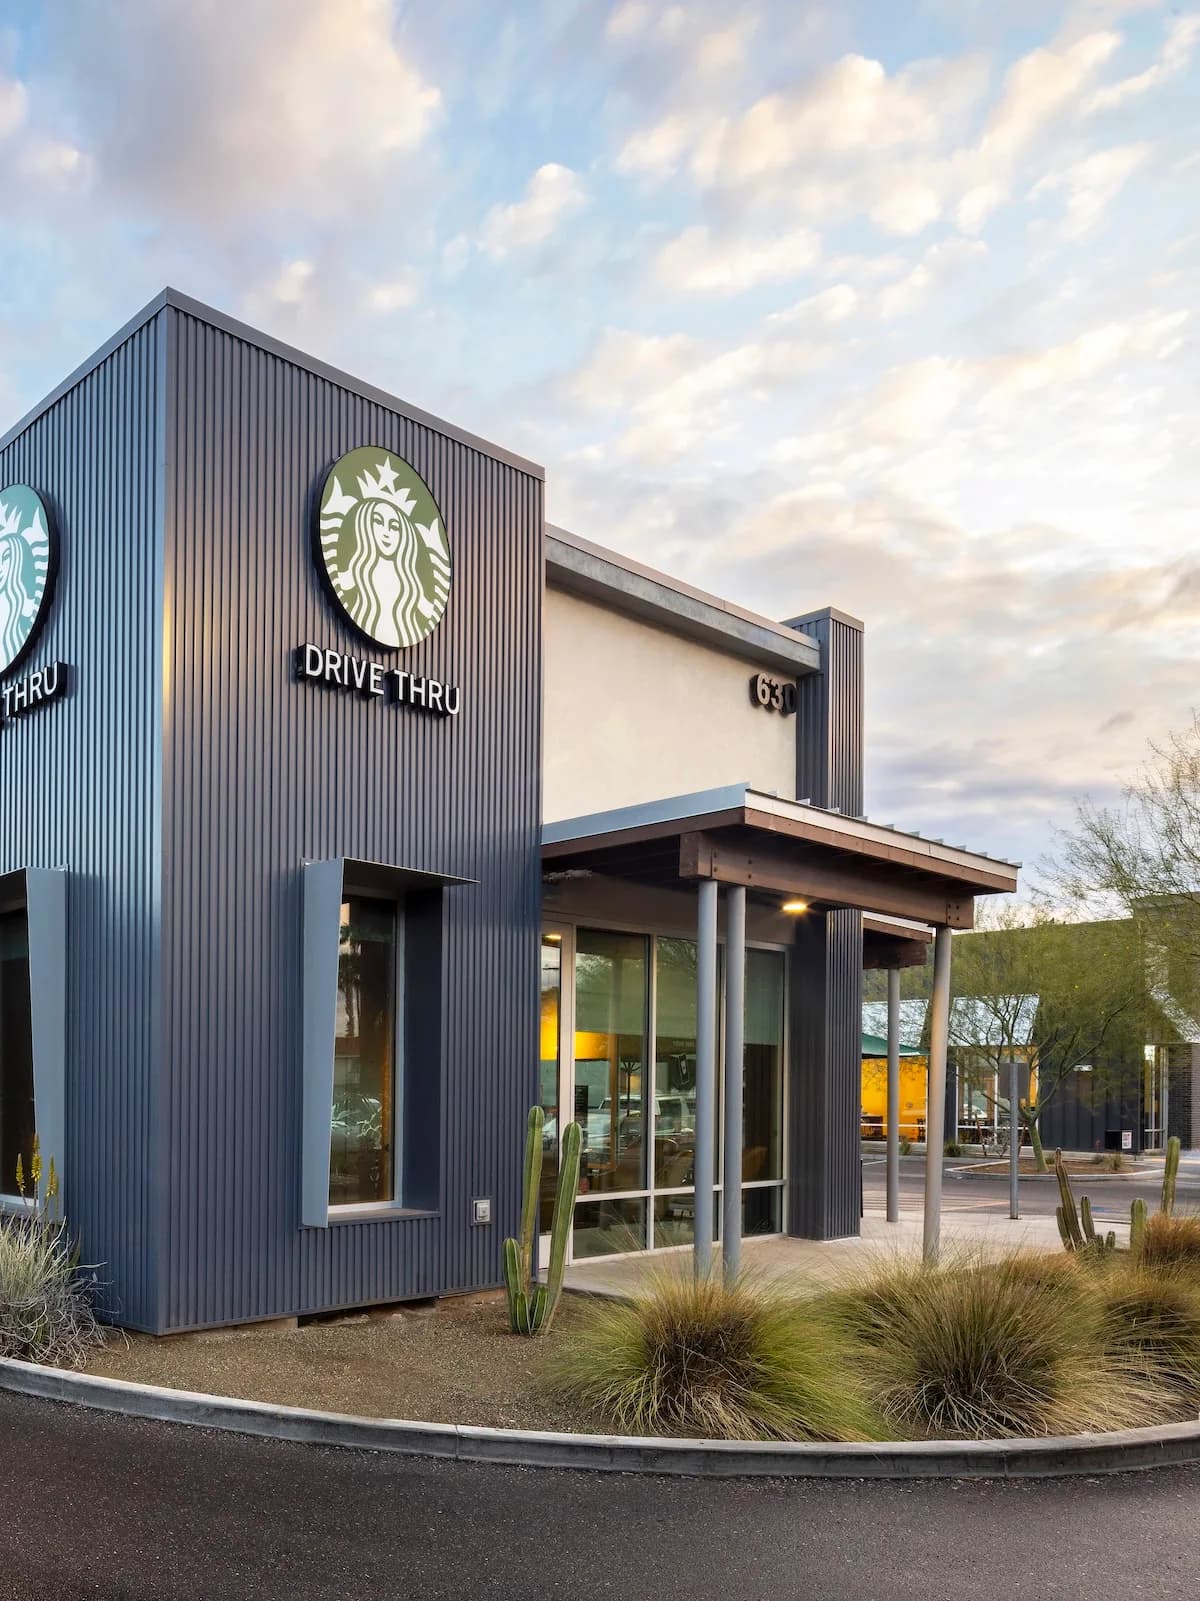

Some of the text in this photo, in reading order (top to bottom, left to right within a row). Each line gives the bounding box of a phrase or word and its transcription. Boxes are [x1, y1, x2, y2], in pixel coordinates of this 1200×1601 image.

[3, 661, 58, 717] THRU
[305, 643, 459, 715] DRIVE THRU
